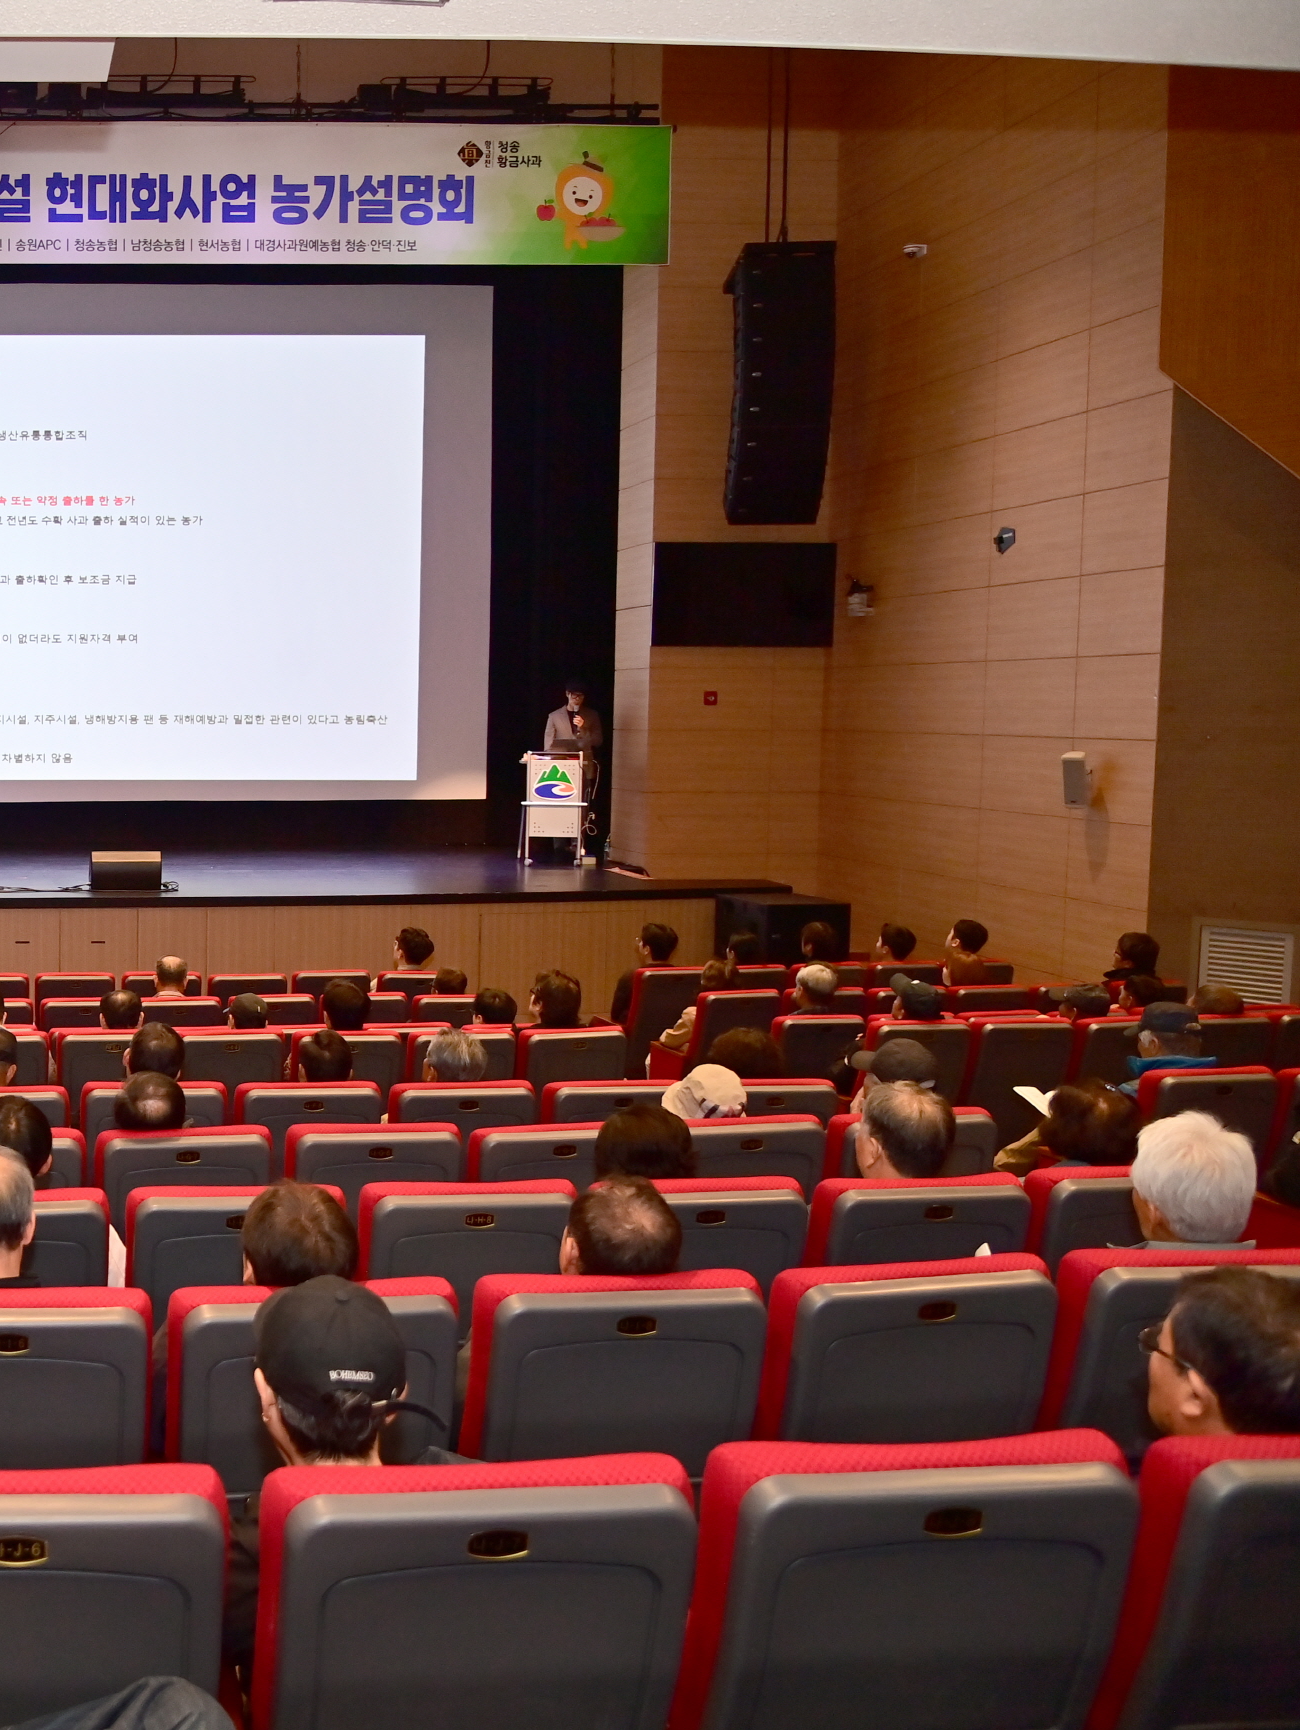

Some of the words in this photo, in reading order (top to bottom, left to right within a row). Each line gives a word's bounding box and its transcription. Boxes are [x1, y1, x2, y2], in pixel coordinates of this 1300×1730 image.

[498, 140, 520, 154] 청송
[497, 155, 542, 168] 황금사과
[45, 172, 256, 223] 현대화사업
[271, 174, 475, 225] 농가설명회
[15, 239, 62, 252] 송원APC
[74, 238, 118, 252] 청송농협
[131, 238, 185, 252] 남청송농협
[198, 238, 242, 252] 현서농협
[255, 239, 341, 252] 대경사과원예농협
[345, 238, 418, 252] 청송·안덕·진보
[11, 496, 32, 506] 또는
[37, 496, 57, 506] 약정
[99, 496, 109, 506] 한
[113, 496, 135, 506] 농가
[7, 516, 38, 526] 전년도
[67, 516, 88, 525] 사과
[118, 516, 149, 525] 실적이
[156, 516, 176, 525] 있는
[181, 516, 203, 526] 농가
[63, 575, 73, 585] 후
[78, 575, 110, 585] 보조금
[116, 575, 137, 585] 지급
[18, 634, 61, 644] 없더라도
[67, 634, 110, 644] 지원자격
[117, 634, 137, 644] 부여
[85, 715, 139, 724] 냉해방지용
[144, 715, 153, 724] 팬
[158, 715, 169, 724] 등
[174, 715, 228, 724] 재해예방과
[234, 715, 265, 724] 밀접한
[270, 715, 301, 725] 관련이
[308, 715, 339, 724] 있다고
[344, 715, 387, 725] 농림축산
[2, 754, 45, 763] 차별하지
[51, 753, 73, 763] 않음
[466, 1215, 493, 1225] 나-H-8
